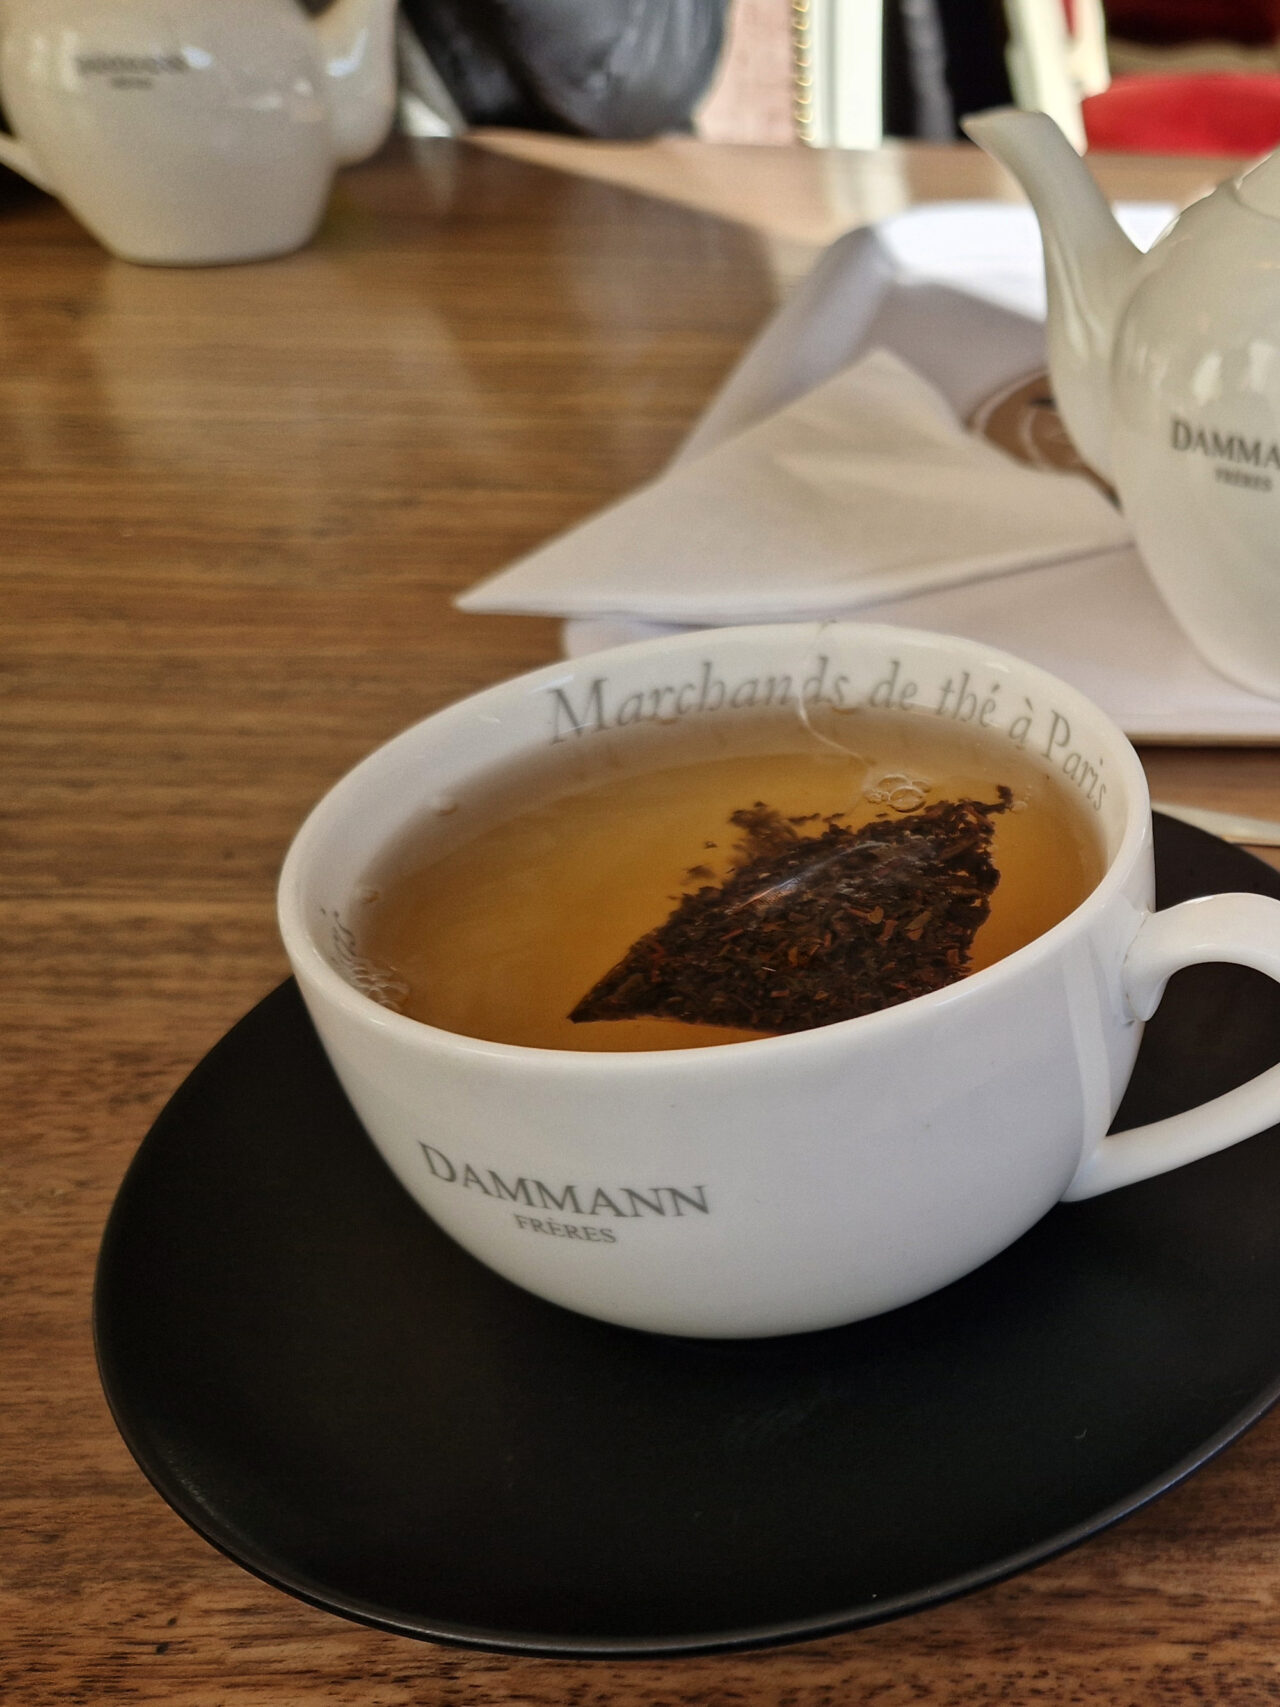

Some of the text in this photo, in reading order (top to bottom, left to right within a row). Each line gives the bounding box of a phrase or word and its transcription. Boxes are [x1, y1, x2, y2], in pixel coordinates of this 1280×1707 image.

[547, 655, 1108, 812] Marchands de thé à Paris
[417, 1140, 710, 1219] DAMMANN
[512, 1213, 617, 1244] FRÈRES
